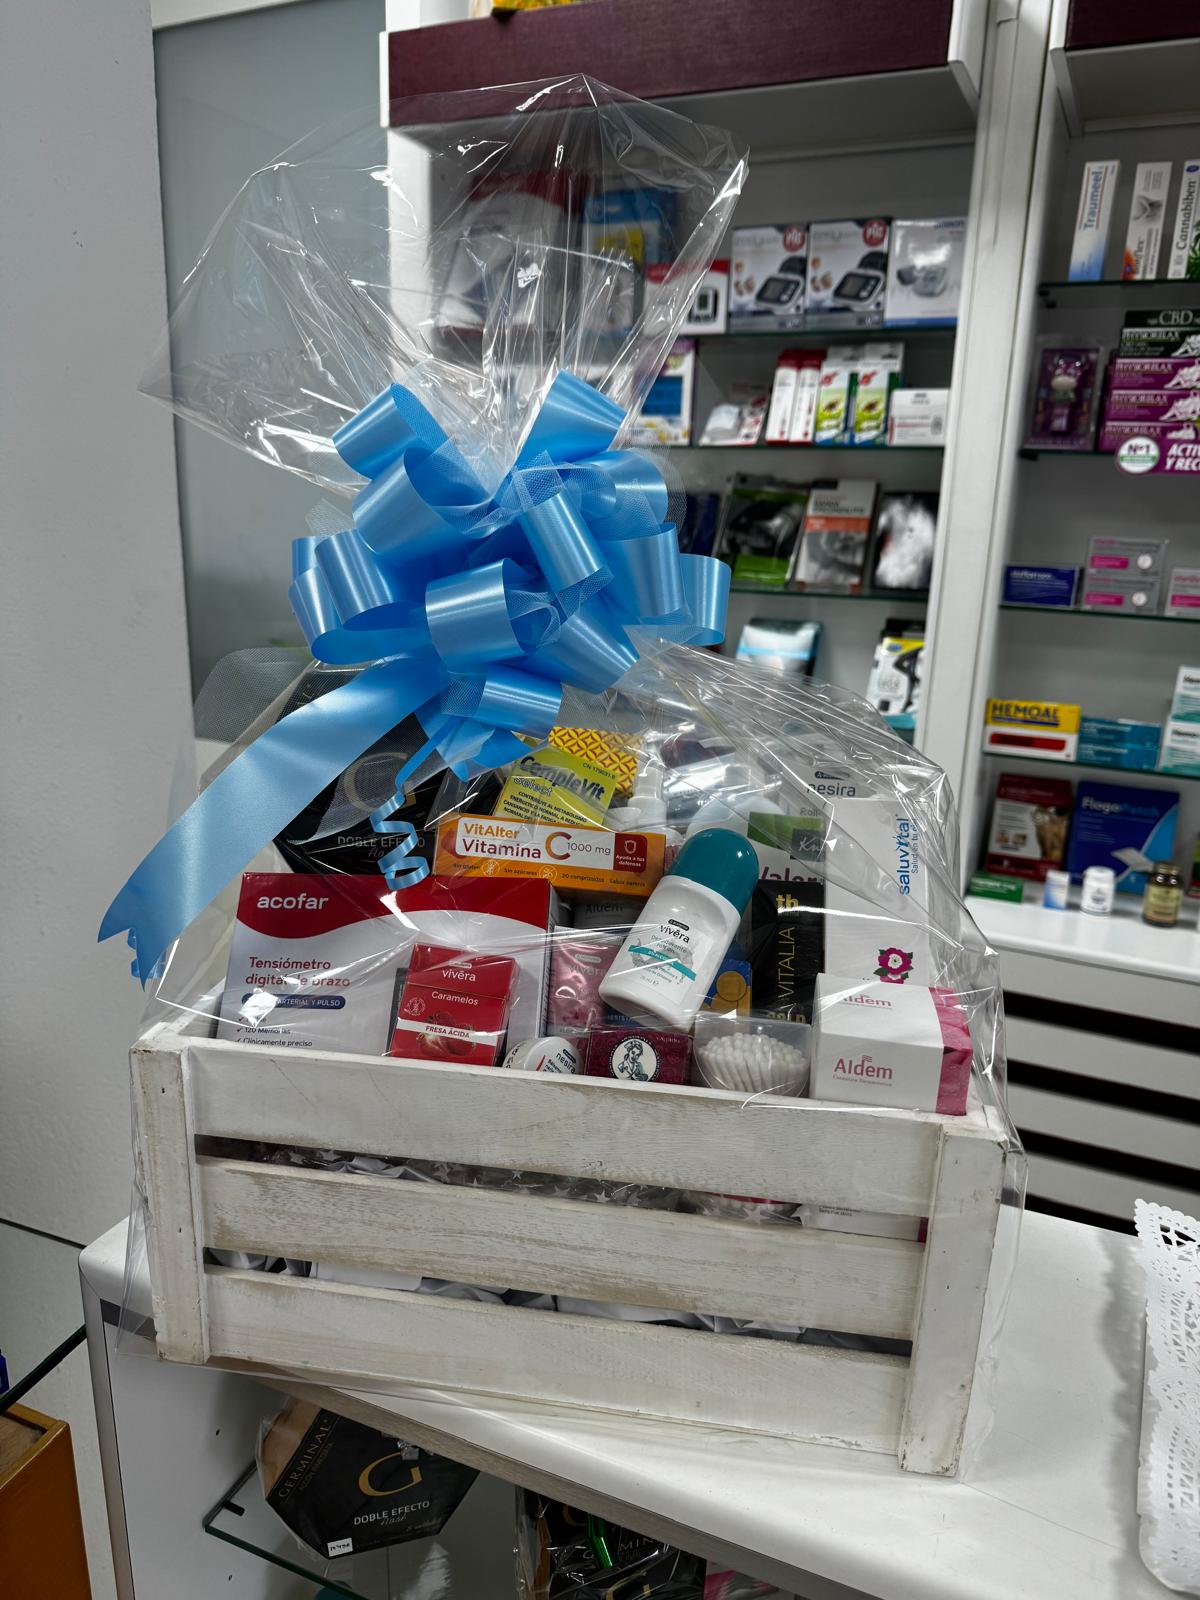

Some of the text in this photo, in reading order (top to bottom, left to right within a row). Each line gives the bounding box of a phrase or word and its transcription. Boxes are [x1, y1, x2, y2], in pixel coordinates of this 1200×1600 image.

[1083, 170, 1103, 230] Traumeel
[1176, 181, 1197, 250] Cannabiben
[1159, 310, 1194, 325] CBD
[991, 702, 1060, 722] HEMOAL
[520, 756, 605, 801] CompleVit
[464, 822, 520, 839] VitAlter
[462, 831, 611, 860] Vitamina C 1000 mg
[257, 892, 329, 911] acofar
[249, 956, 331, 970] Tensiómetro
[778, 926, 796, 998] VITALIA
[432, 990, 479, 1006] Caramelos
[842, 994, 892, 1007] ldem
[243, 1037, 313, 1048] Clínicamente preciso
[425, 1025, 471, 1039] FRESA ÁCIDA
[555, 1052, 577, 1074] nesira
[834, 1055, 893, 1080] Aldem
[278, 1422, 332, 1498] GERMINAL
[353, 1500, 431, 1526] DOBLE EFECTO
